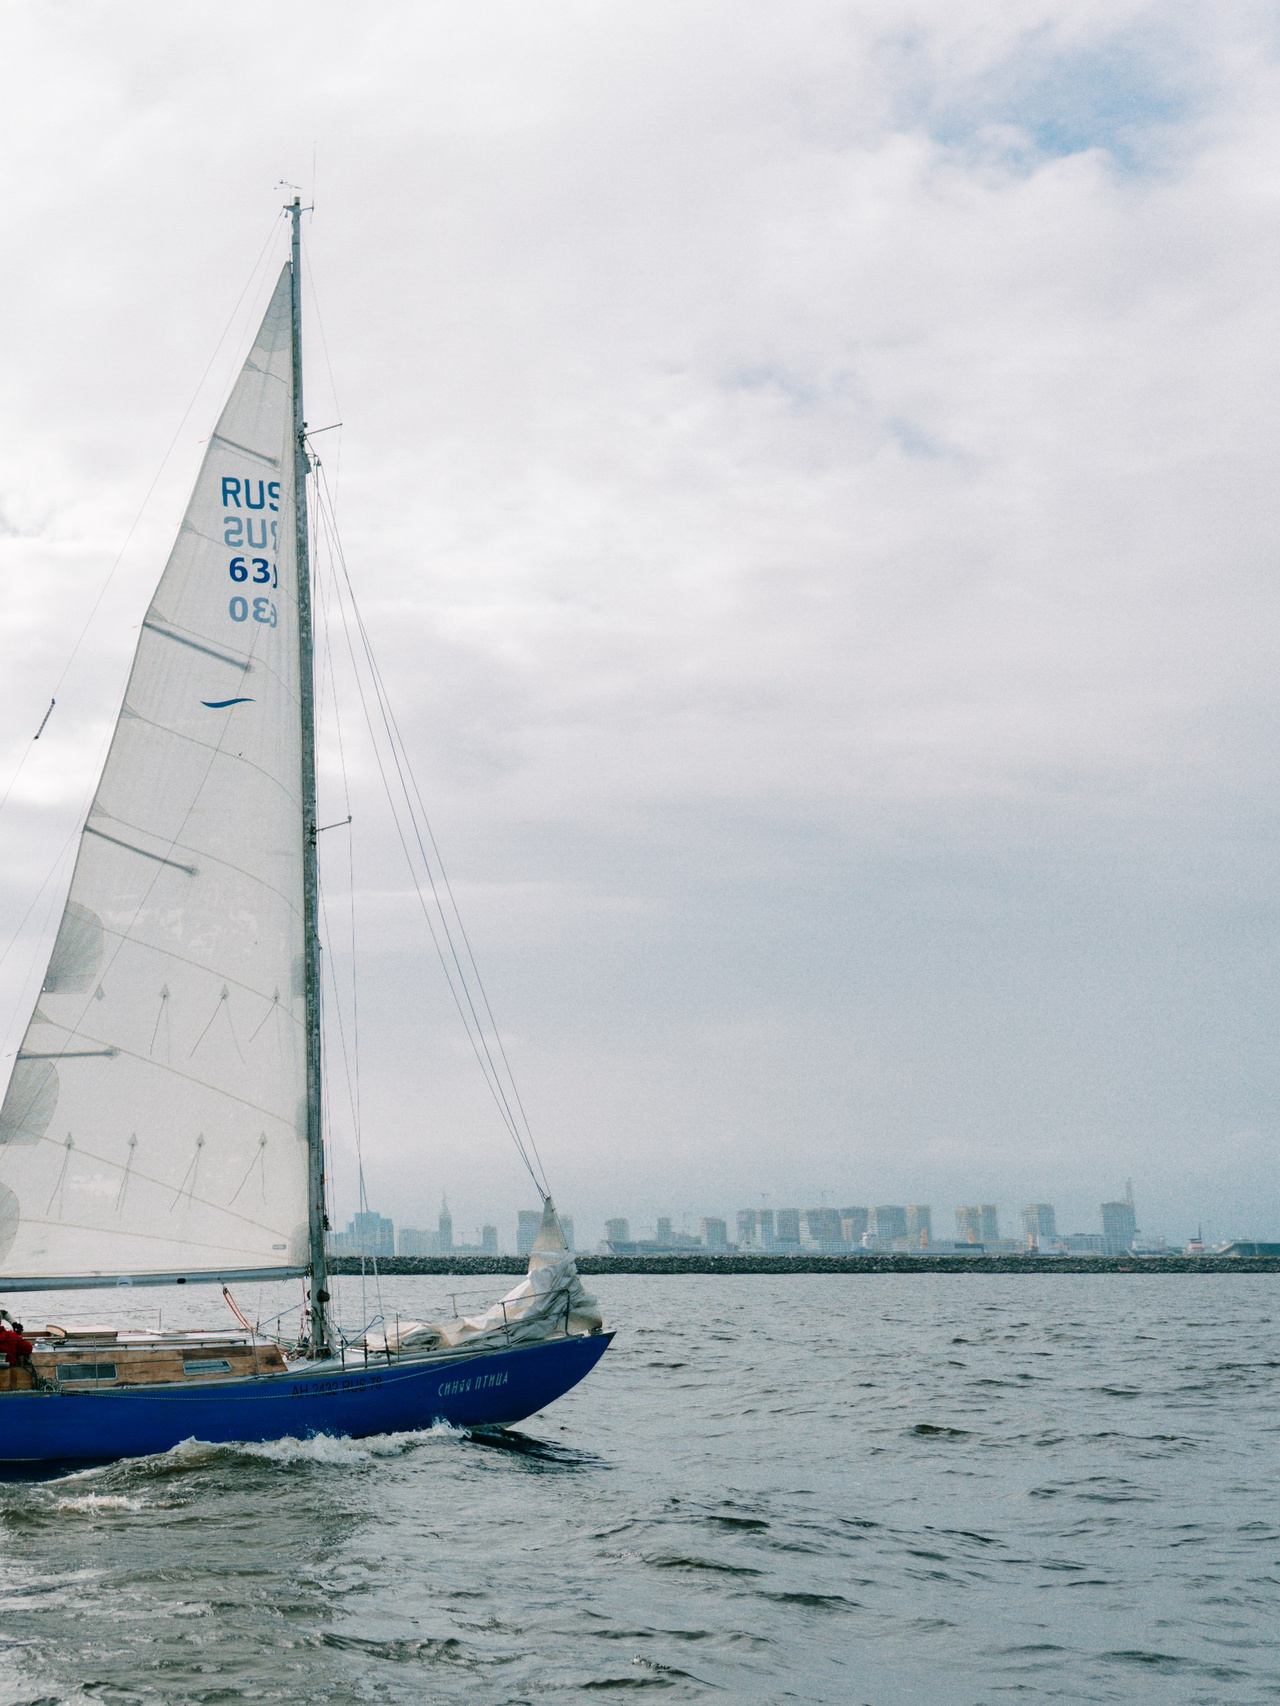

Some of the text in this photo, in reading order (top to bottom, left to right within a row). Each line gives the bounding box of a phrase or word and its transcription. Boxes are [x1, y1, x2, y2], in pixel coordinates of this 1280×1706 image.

[222, 477, 280, 511] RUS
[342, 1378, 366, 1393] RUS
[475, 1371, 508, 1390] ПТИЦА
